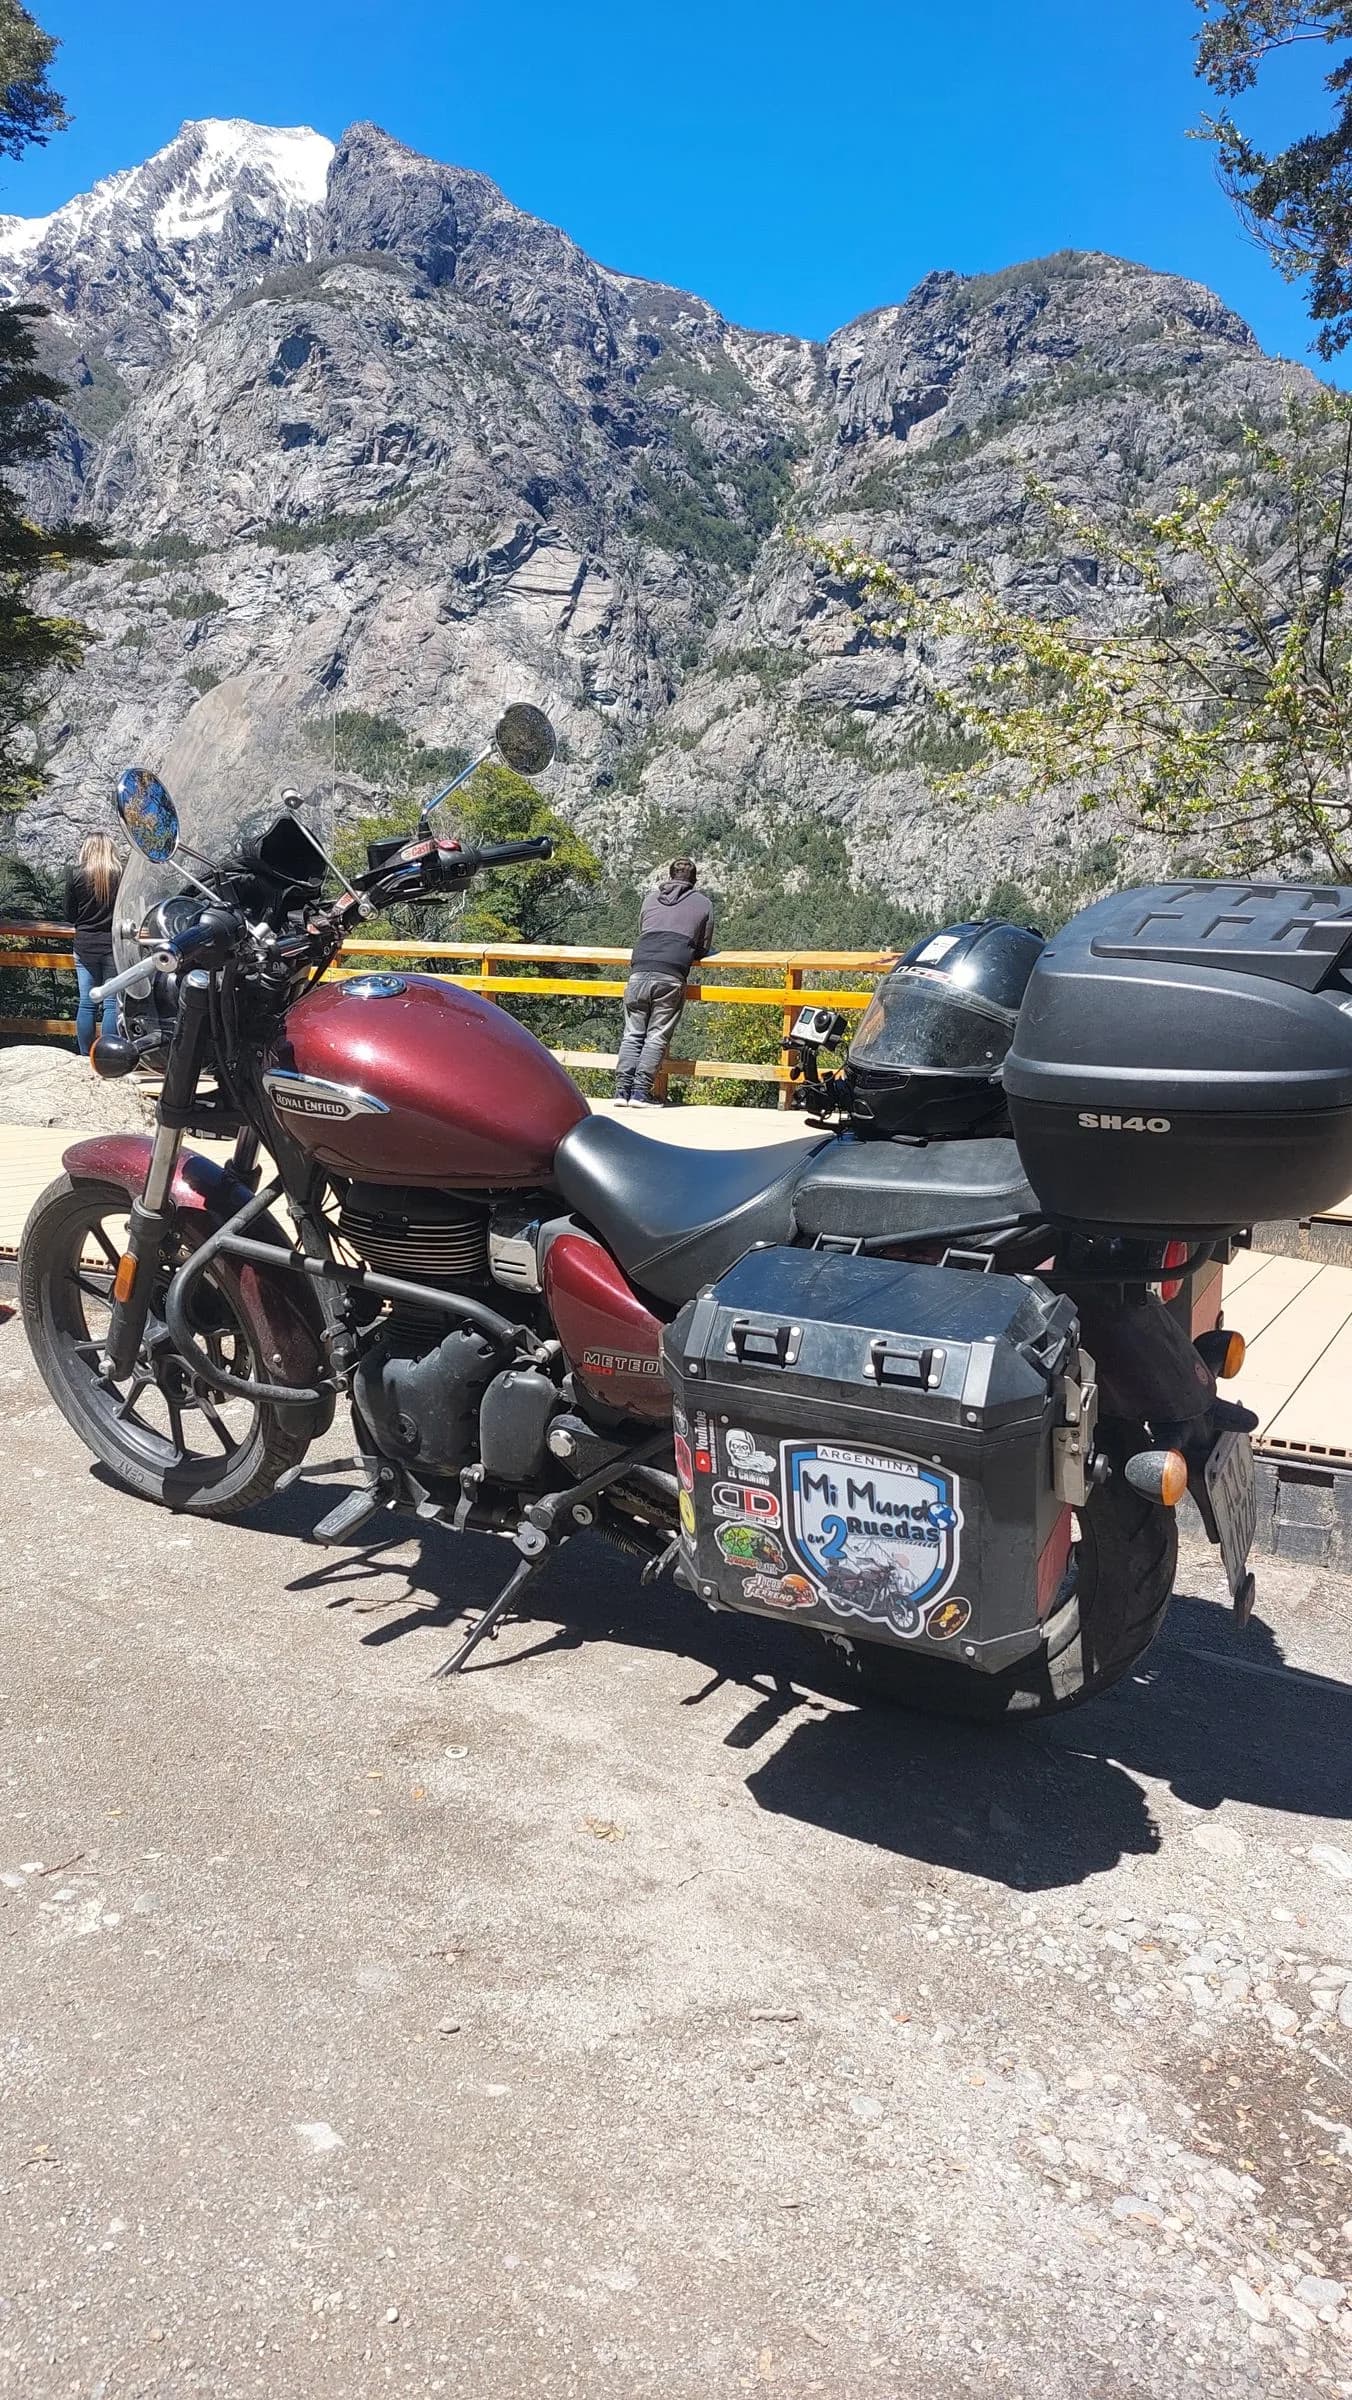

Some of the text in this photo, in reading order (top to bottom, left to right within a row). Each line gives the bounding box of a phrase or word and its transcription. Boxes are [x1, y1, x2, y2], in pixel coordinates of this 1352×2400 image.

[276, 1094, 345, 1115] ROYAL ENFIELD
[1078, 1112, 1171, 1133] SH40
[583, 1350, 659, 1374] METEO
[694, 1410, 709, 1450] YouTube
[119, 1460, 145, 1484] CEAT
[727, 1465, 738, 1479] EL
[820, 1448, 916, 1474] ARGENTINA
[802, 1470, 838, 1507] Mi
[807, 1514, 940, 1559] en 2 Ruedas
